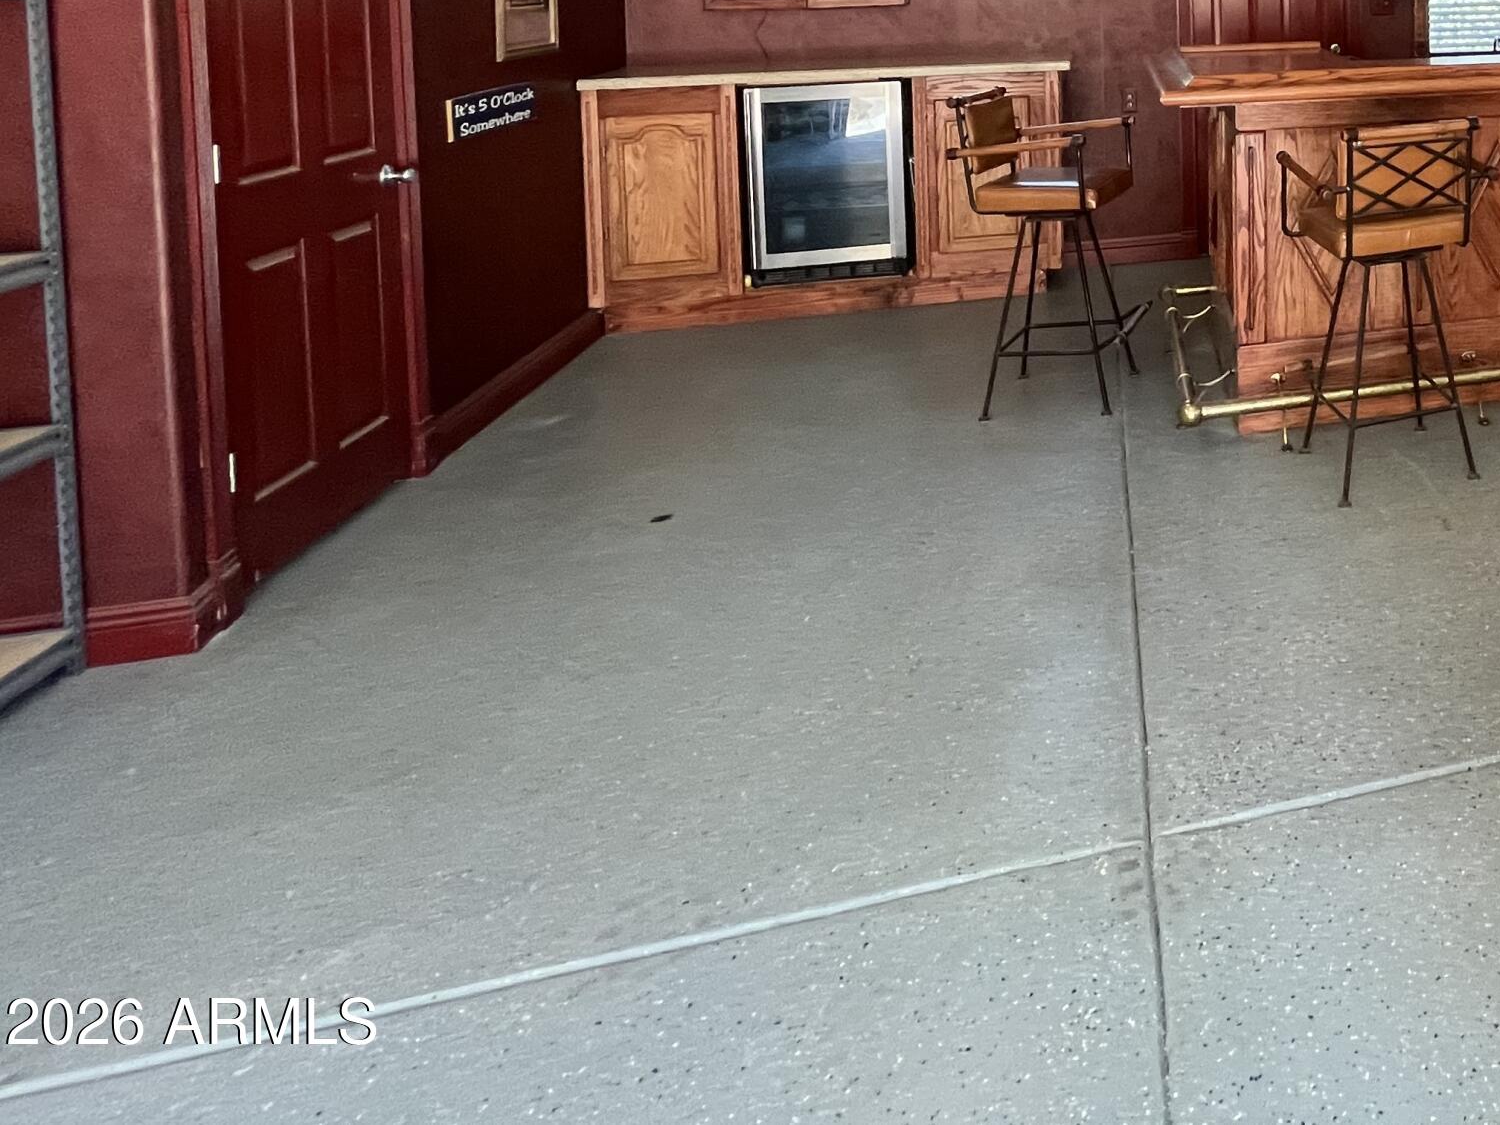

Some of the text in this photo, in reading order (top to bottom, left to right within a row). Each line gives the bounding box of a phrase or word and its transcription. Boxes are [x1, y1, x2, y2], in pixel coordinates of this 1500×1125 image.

[454, 87, 535, 118] It's 5 O'Clock
[460, 109, 531, 137] Somewhere
